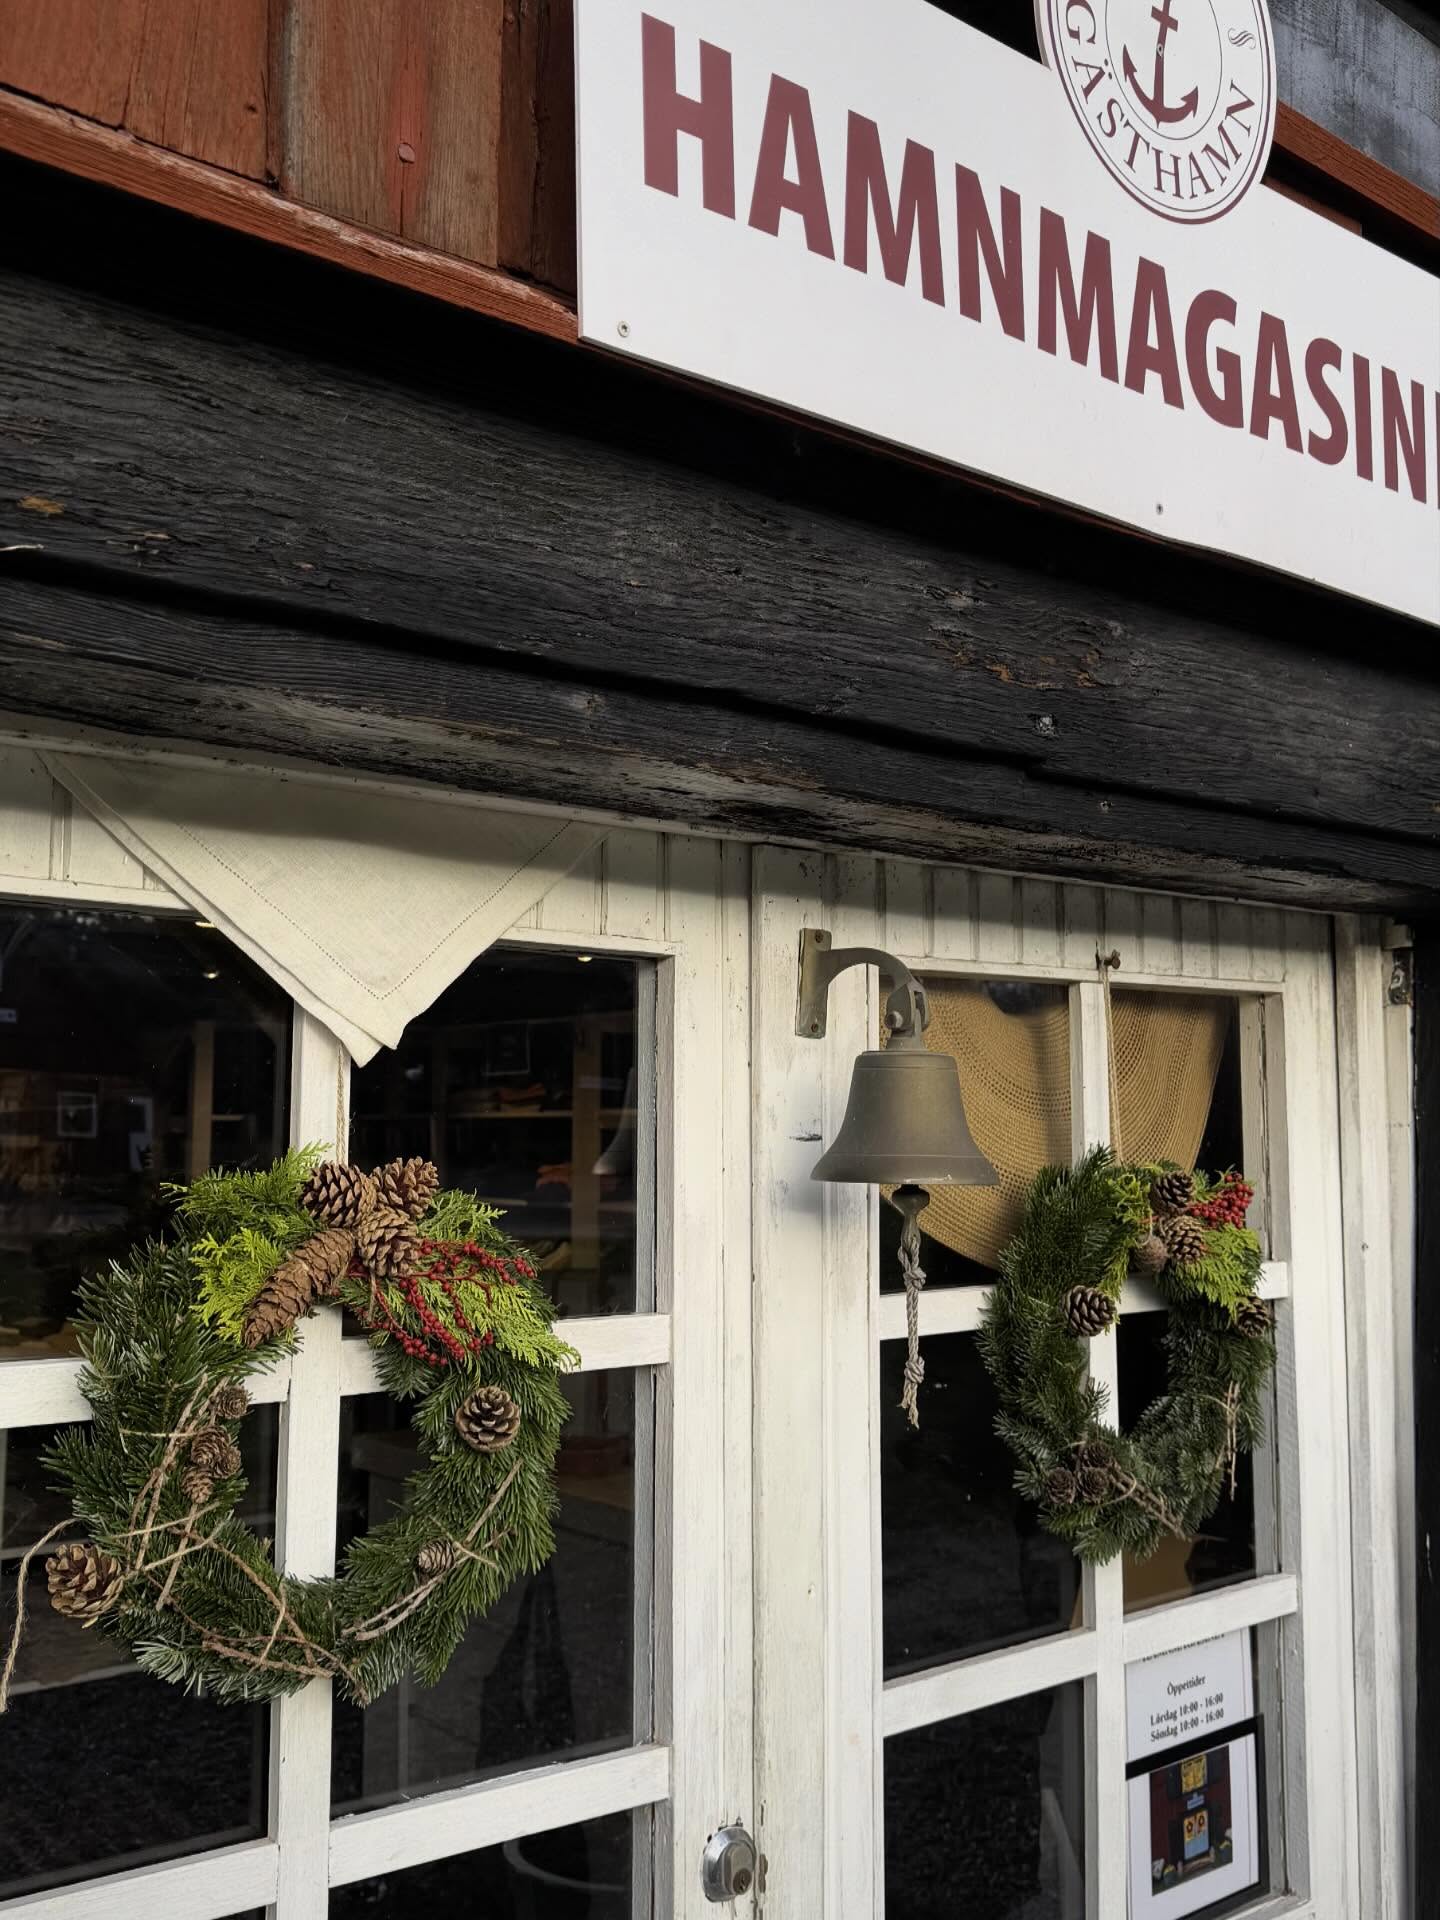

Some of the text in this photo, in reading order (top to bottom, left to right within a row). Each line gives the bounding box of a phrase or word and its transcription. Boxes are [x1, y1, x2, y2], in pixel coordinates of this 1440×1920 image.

[1065, 0, 1256, 200] GÄSTHAMN
[641, 12, 1440, 511] HAMNMAGASIN
[1167, 1675, 1206, 1696] Öppettider
[1150, 1709, 1177, 1726] Lördag
[1179, 1701, 1198, 1717] 10:00
[1205, 1692, 1223, 1708] 16:00
[1150, 1725, 1178, 1742] Söndag
[1180, 1717, 1199, 1732] 10:00
[1206, 1708, 1224, 1724] 16:00
